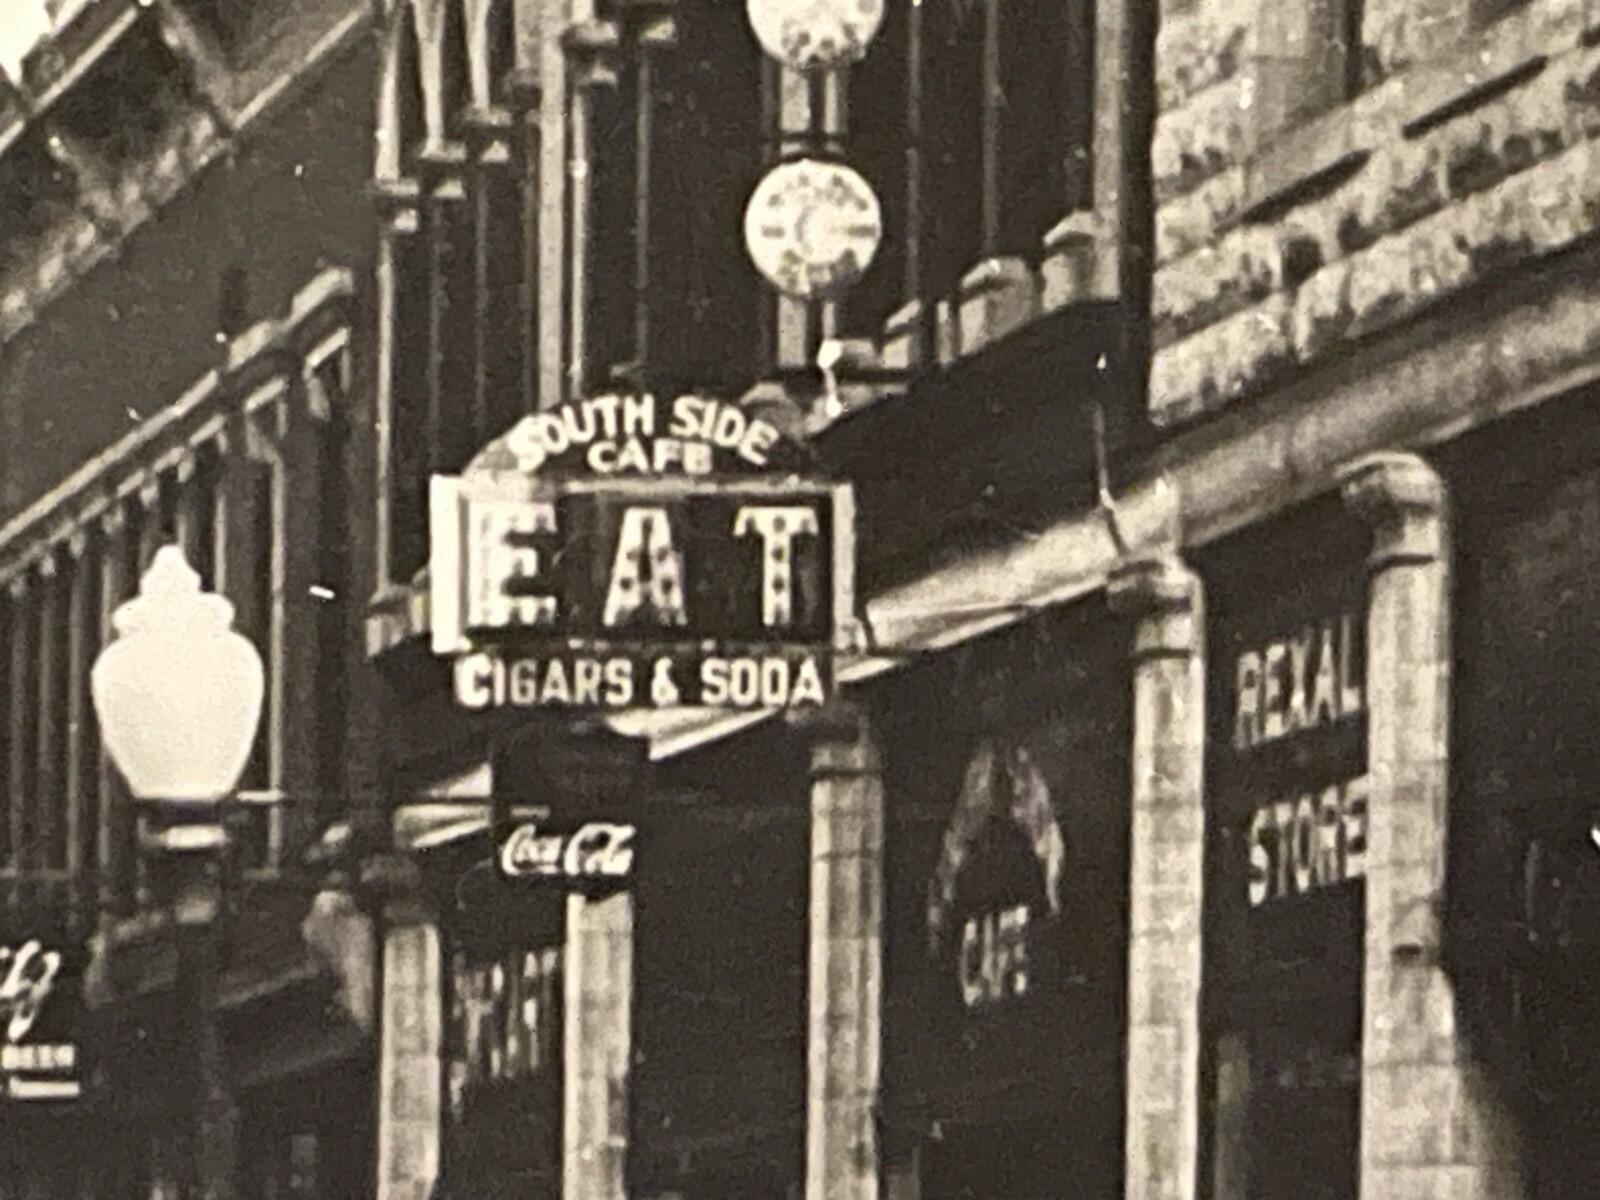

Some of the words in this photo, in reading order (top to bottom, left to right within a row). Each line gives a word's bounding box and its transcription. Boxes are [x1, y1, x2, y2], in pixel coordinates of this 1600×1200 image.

[506, 393, 655, 474] SOUTH
[669, 394, 780, 466] SIDE
[468, 501, 819, 628] EAT
[454, 653, 633, 707] CIGARS
[651, 656, 680, 707] &
[700, 656, 825, 706] SODA
[1248, 772, 1370, 908] STORE
